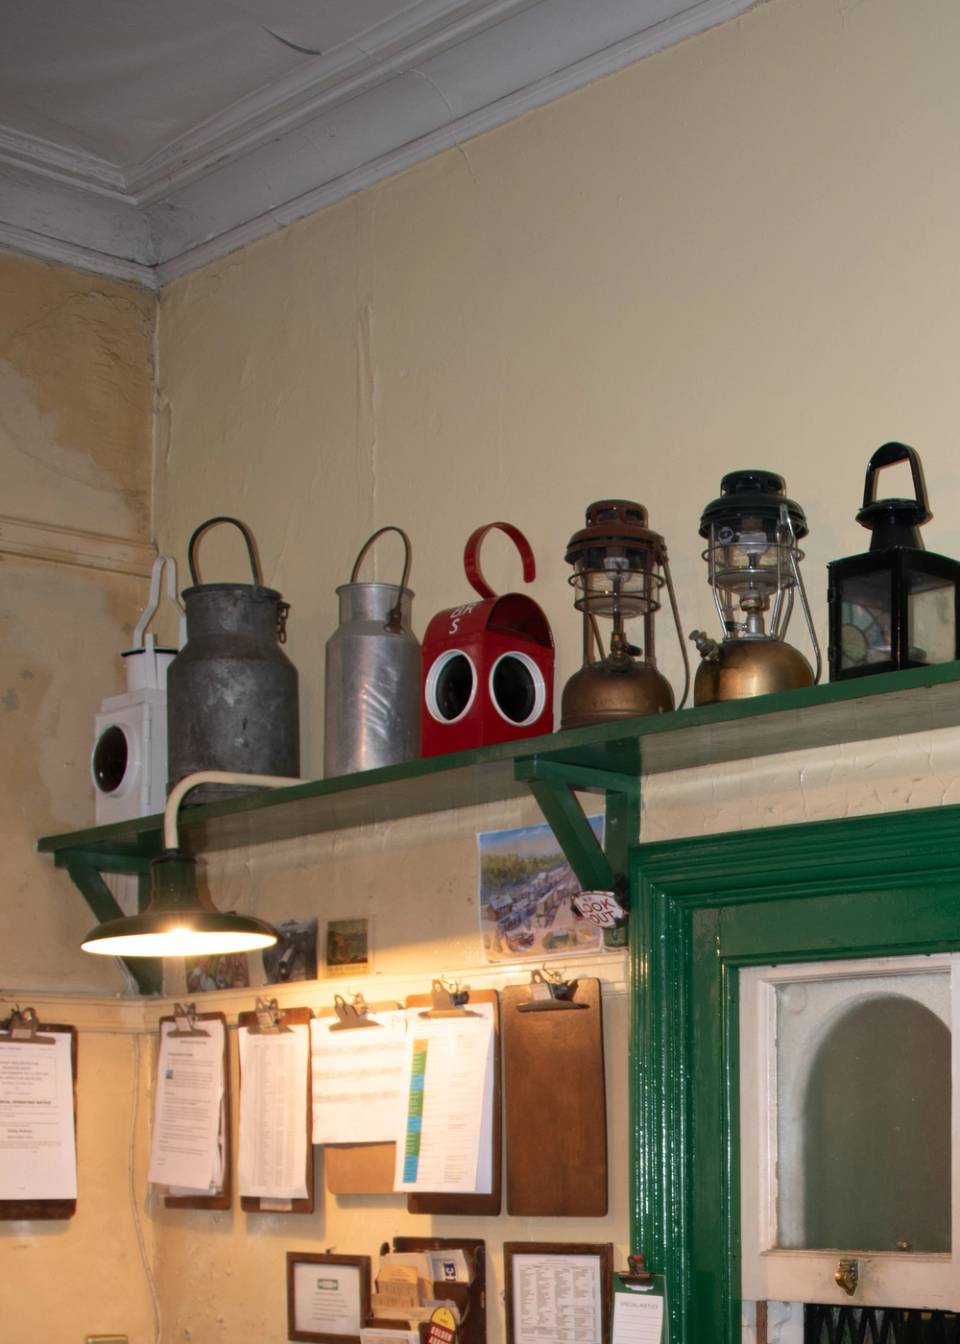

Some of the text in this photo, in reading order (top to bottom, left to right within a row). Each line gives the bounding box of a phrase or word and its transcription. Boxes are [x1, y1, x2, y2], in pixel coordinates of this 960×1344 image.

[576, 898, 616, 914] LOOK
[590, 910, 615, 924] OUT
[430, 1325, 453, 1341] GOLDEN
